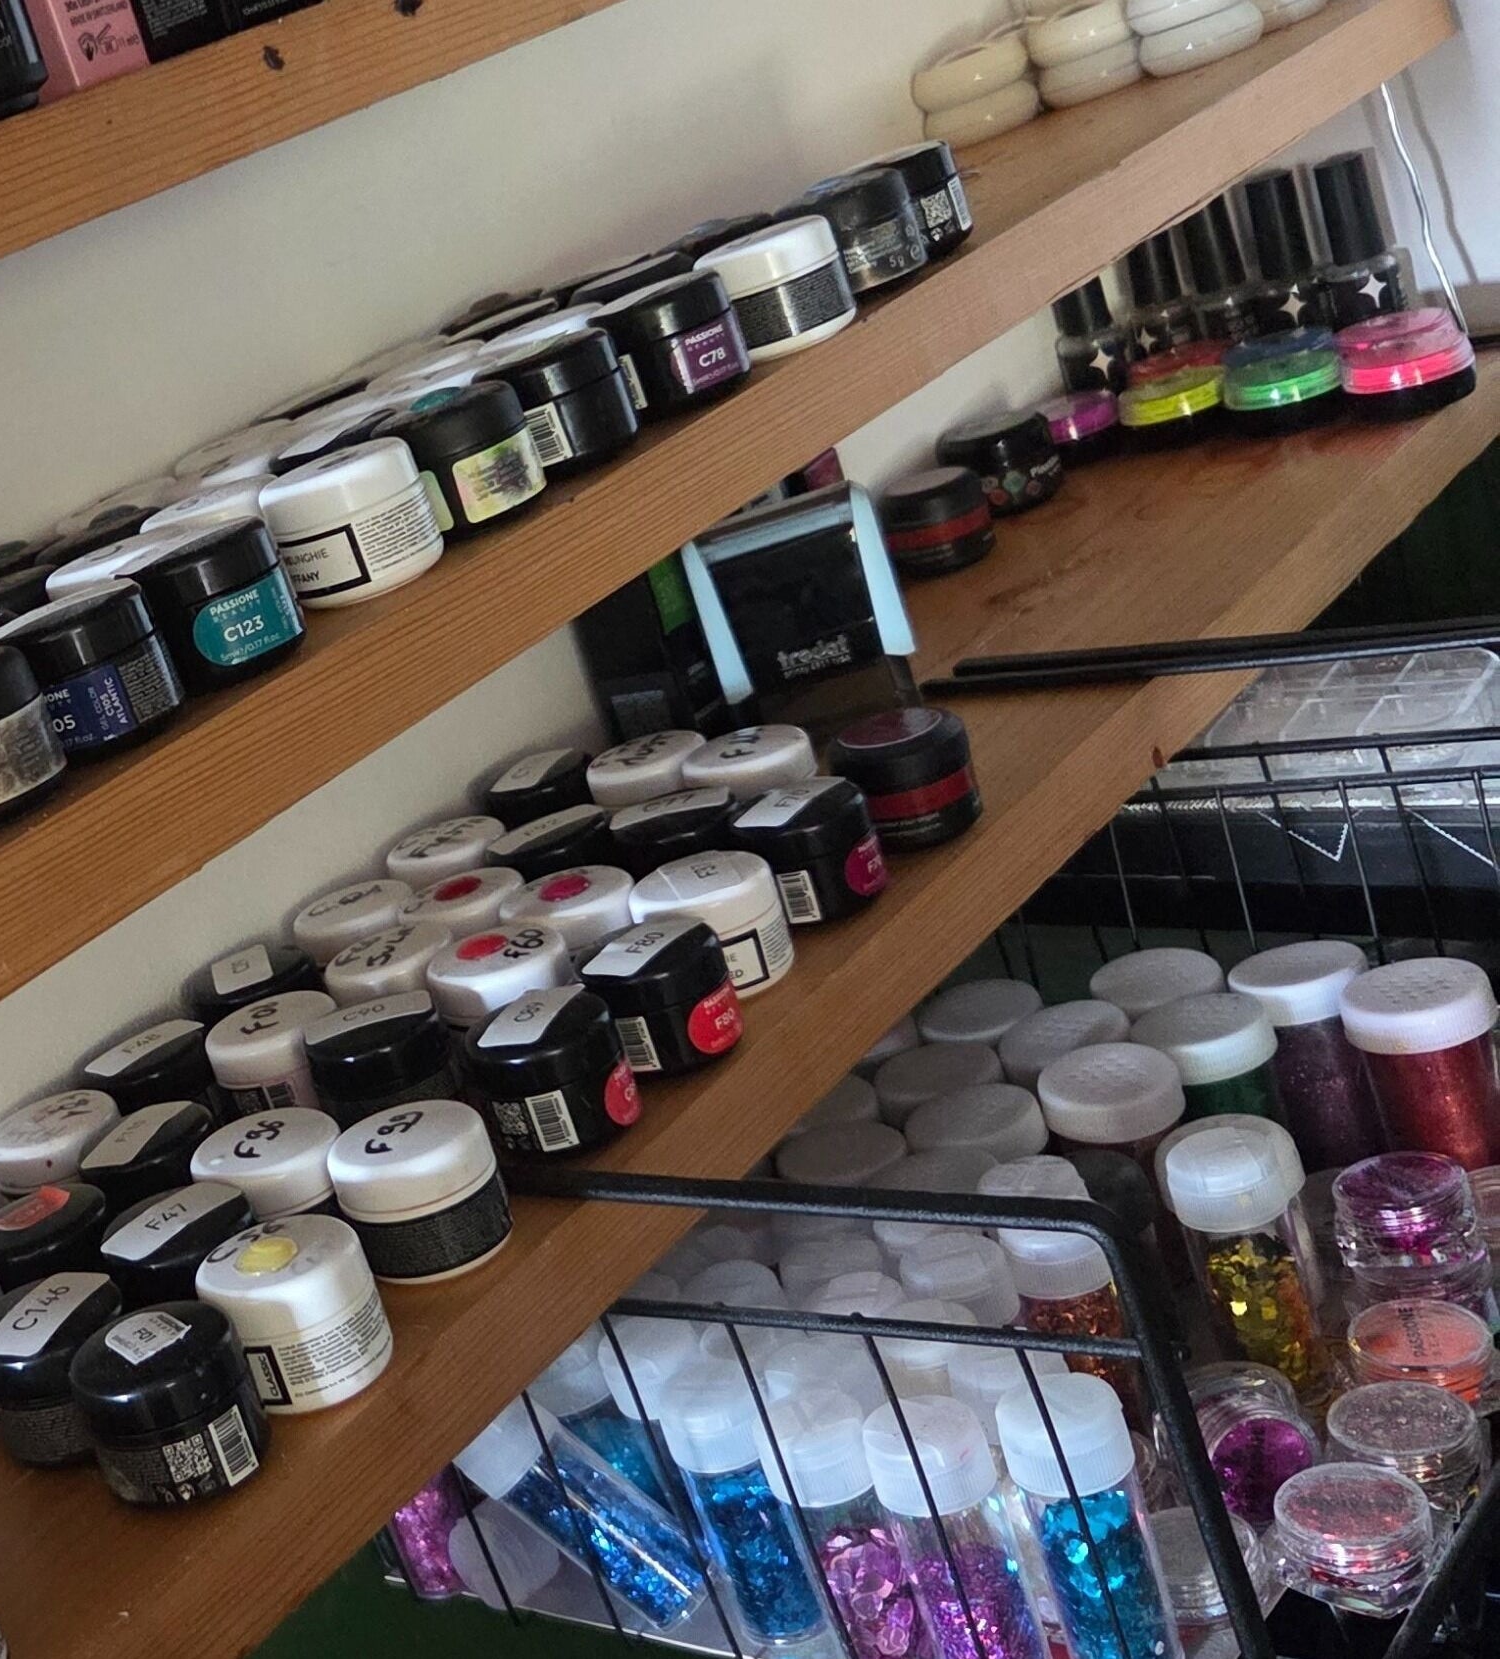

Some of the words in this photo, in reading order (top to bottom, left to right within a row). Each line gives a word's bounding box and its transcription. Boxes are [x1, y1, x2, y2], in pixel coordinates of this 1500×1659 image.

[699, 347, 726, 367] C78
[210, 589, 260, 616] PASSIONE
[224, 615, 264, 642] C123
[104, 677, 128, 723] ATLANTIC
[12, 1285, 70, 1331] C146
